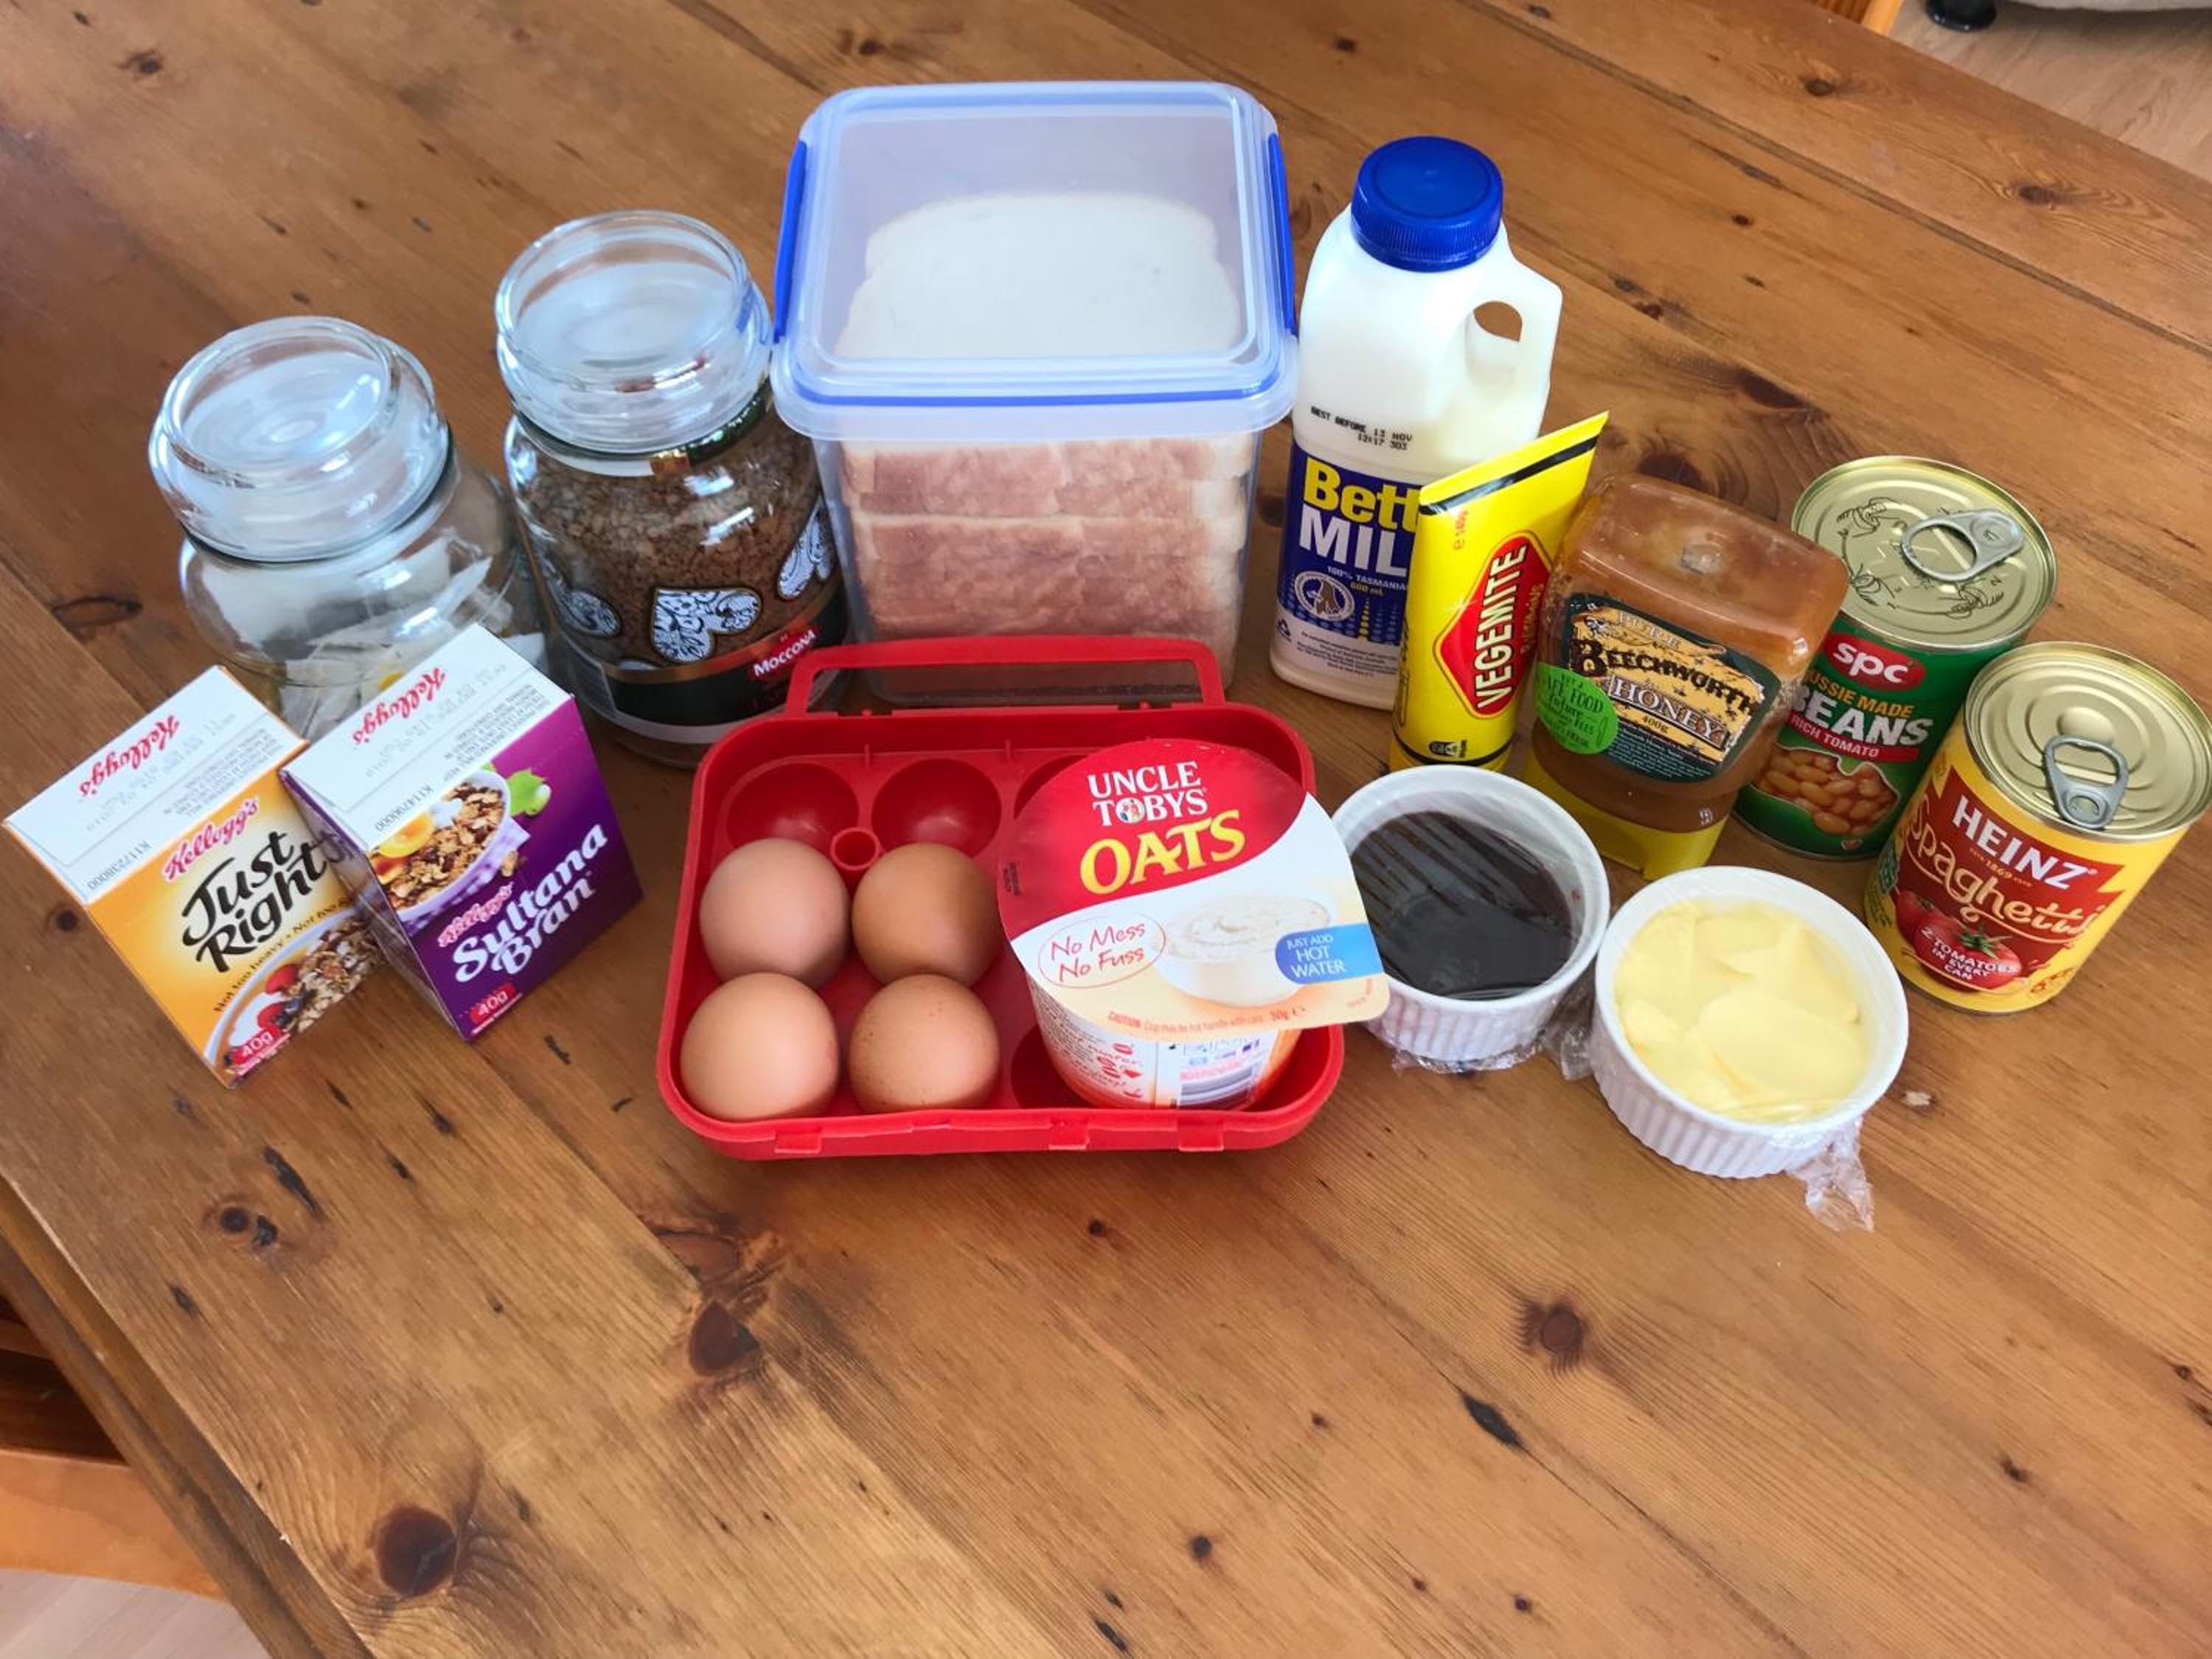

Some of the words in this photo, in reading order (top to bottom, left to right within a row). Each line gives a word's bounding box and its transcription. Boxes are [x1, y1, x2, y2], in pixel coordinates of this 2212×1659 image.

[1311, 406, 1330, 420] BEST
[1335, 416, 1366, 433] BEFORE
[1392, 433, 1413, 442] NOV
[1304, 456, 1420, 533] Bett
[1299, 503, 1408, 577] MIL
[1356, 575, 1407, 591] TASMANIA
[1477, 543, 1526, 709] VEGEMITE
[753, 630, 815, 676] MOCCONA
[1833, 642, 1908, 684] spc
[1613, 677, 1726, 740] HONEY
[1809, 672, 1857, 706] USSIE
[1857, 695, 1915, 719] MADE
[1642, 715, 1669, 734] 400g
[1823, 732, 1879, 758] TOMATO
[1088, 760, 1202, 799] UNCLE
[1092, 789, 1208, 827] TOBYS
[161, 797, 260, 882] Kellogg's
[1079, 809, 1247, 895] OATS
[1952, 794, 2089, 890] HEINZ
[1907, 793, 2107, 935] Spaghetti
[1986, 858, 2013, 880] 1869
[181, 830, 294, 947] Just
[195, 842, 327, 973] Right
[453, 822, 609, 983] Sultana
[490, 877, 594, 975] Bran
[1051, 936, 1082, 959] No
[1089, 922, 1146, 952] Mess
[1286, 937, 1310, 950] JUST
[1310, 933, 1333, 945] ADD
[1059, 958, 1091, 983] No
[1097, 947, 1145, 974] Fuss
[1290, 959, 1346, 978] WATER
[1295, 945, 1331, 962] HOT
[1933, 948, 1947, 960] IN
[1949, 957, 1991, 978] EVERY
[1944, 964, 1973, 981] CAN
